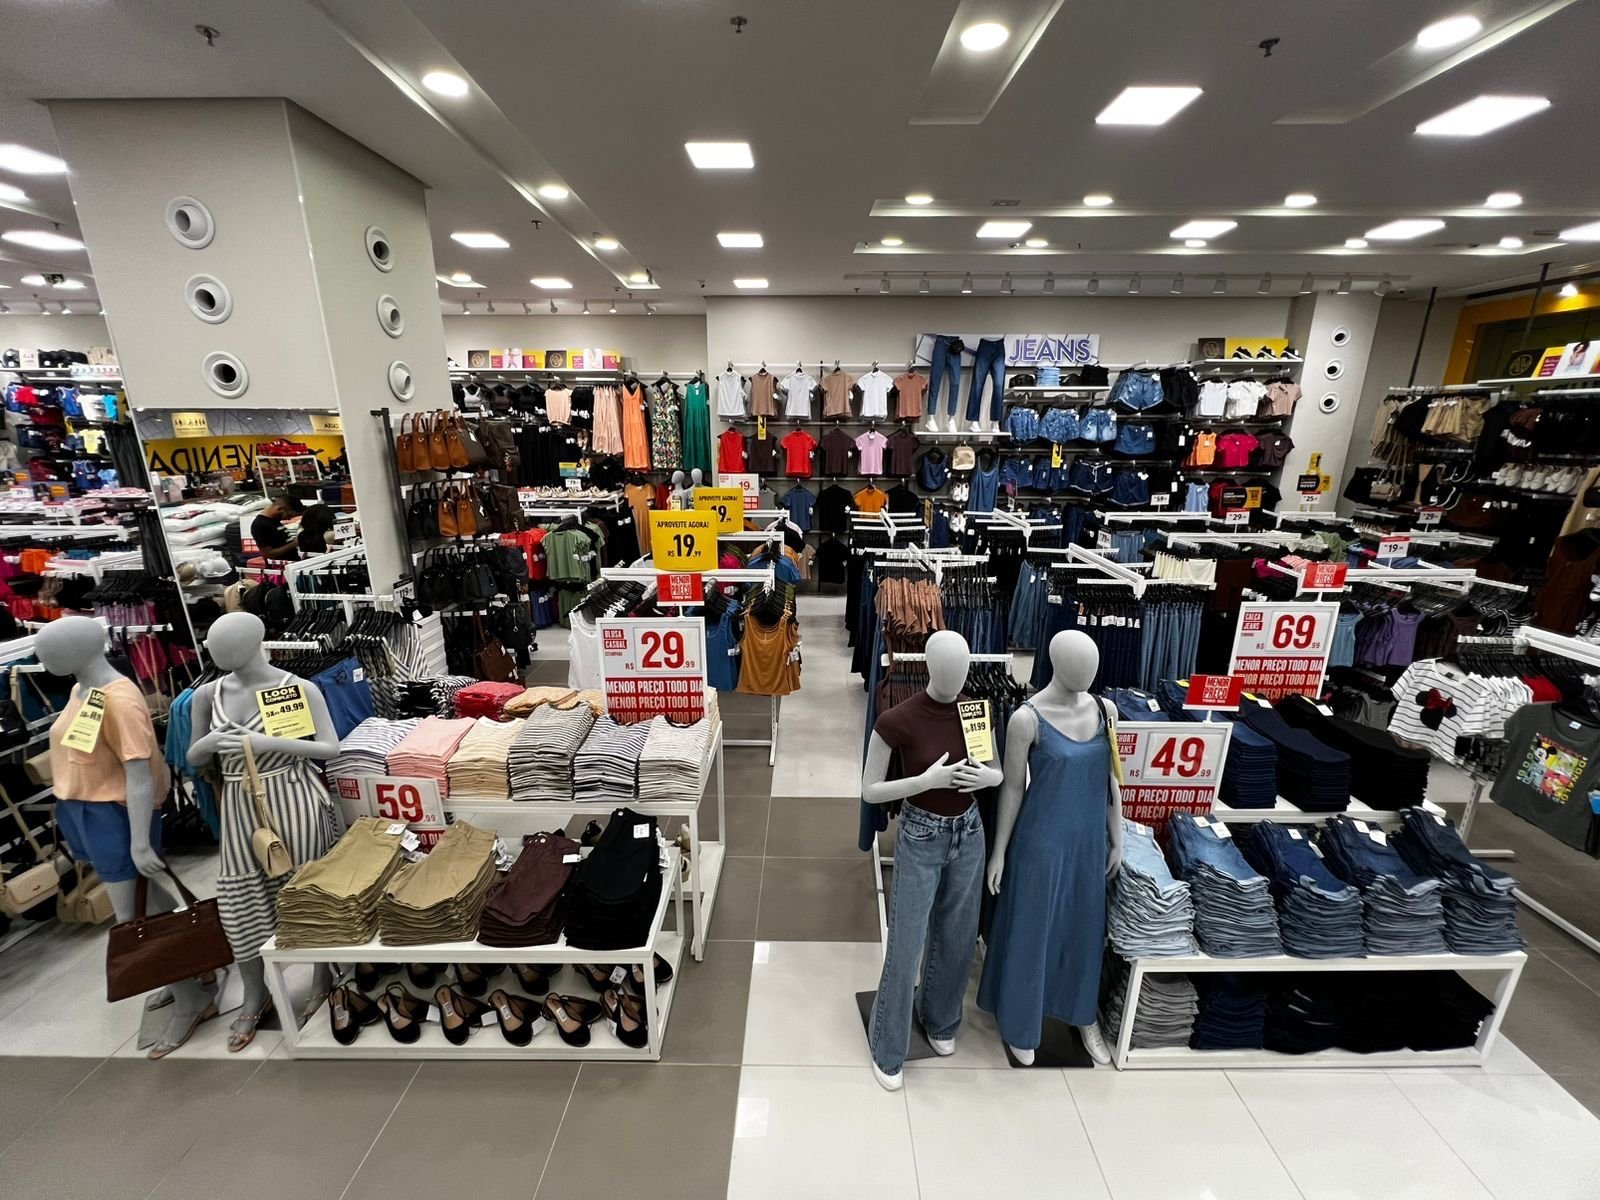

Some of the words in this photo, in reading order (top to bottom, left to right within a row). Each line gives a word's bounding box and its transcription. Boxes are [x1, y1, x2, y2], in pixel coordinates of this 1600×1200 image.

[1009, 339, 1091, 362] JEANS
[605, 640, 626, 649] CASUAL
[1236, 660, 1260, 671] MENOR
[1261, 660, 1287, 672] PREÇO
[1288, 660, 1308, 671] TODO
[1309, 660, 1323, 671] DIA
[1259, 674, 1284, 686] PREÇO
[1285, 674, 1307, 685] TODO
[1306, 674, 1320, 685] DIA
[264, 687, 296, 698] LOOK
[606, 681, 636, 693] MENOR
[637, 680, 664, 694] PREÇO
[666, 680, 688, 693] TODO
[690, 680, 703, 693] DIA
[607, 696, 637, 709] MENOR
[639, 696, 665, 710] PREÇO
[666, 696, 689, 709] TODO
[691, 695, 704, 708] DIA
[961, 703, 981, 713] LOOK
[1130, 769, 1140, 777] R$
[1561, 760, 1588, 801] DONALD
[1138, 789, 1169, 804] PREÇO
[1170, 789, 1195, 803] TODO
[1196, 790, 1213, 803] DIA
[1135, 805, 1165, 819] PREÇO
